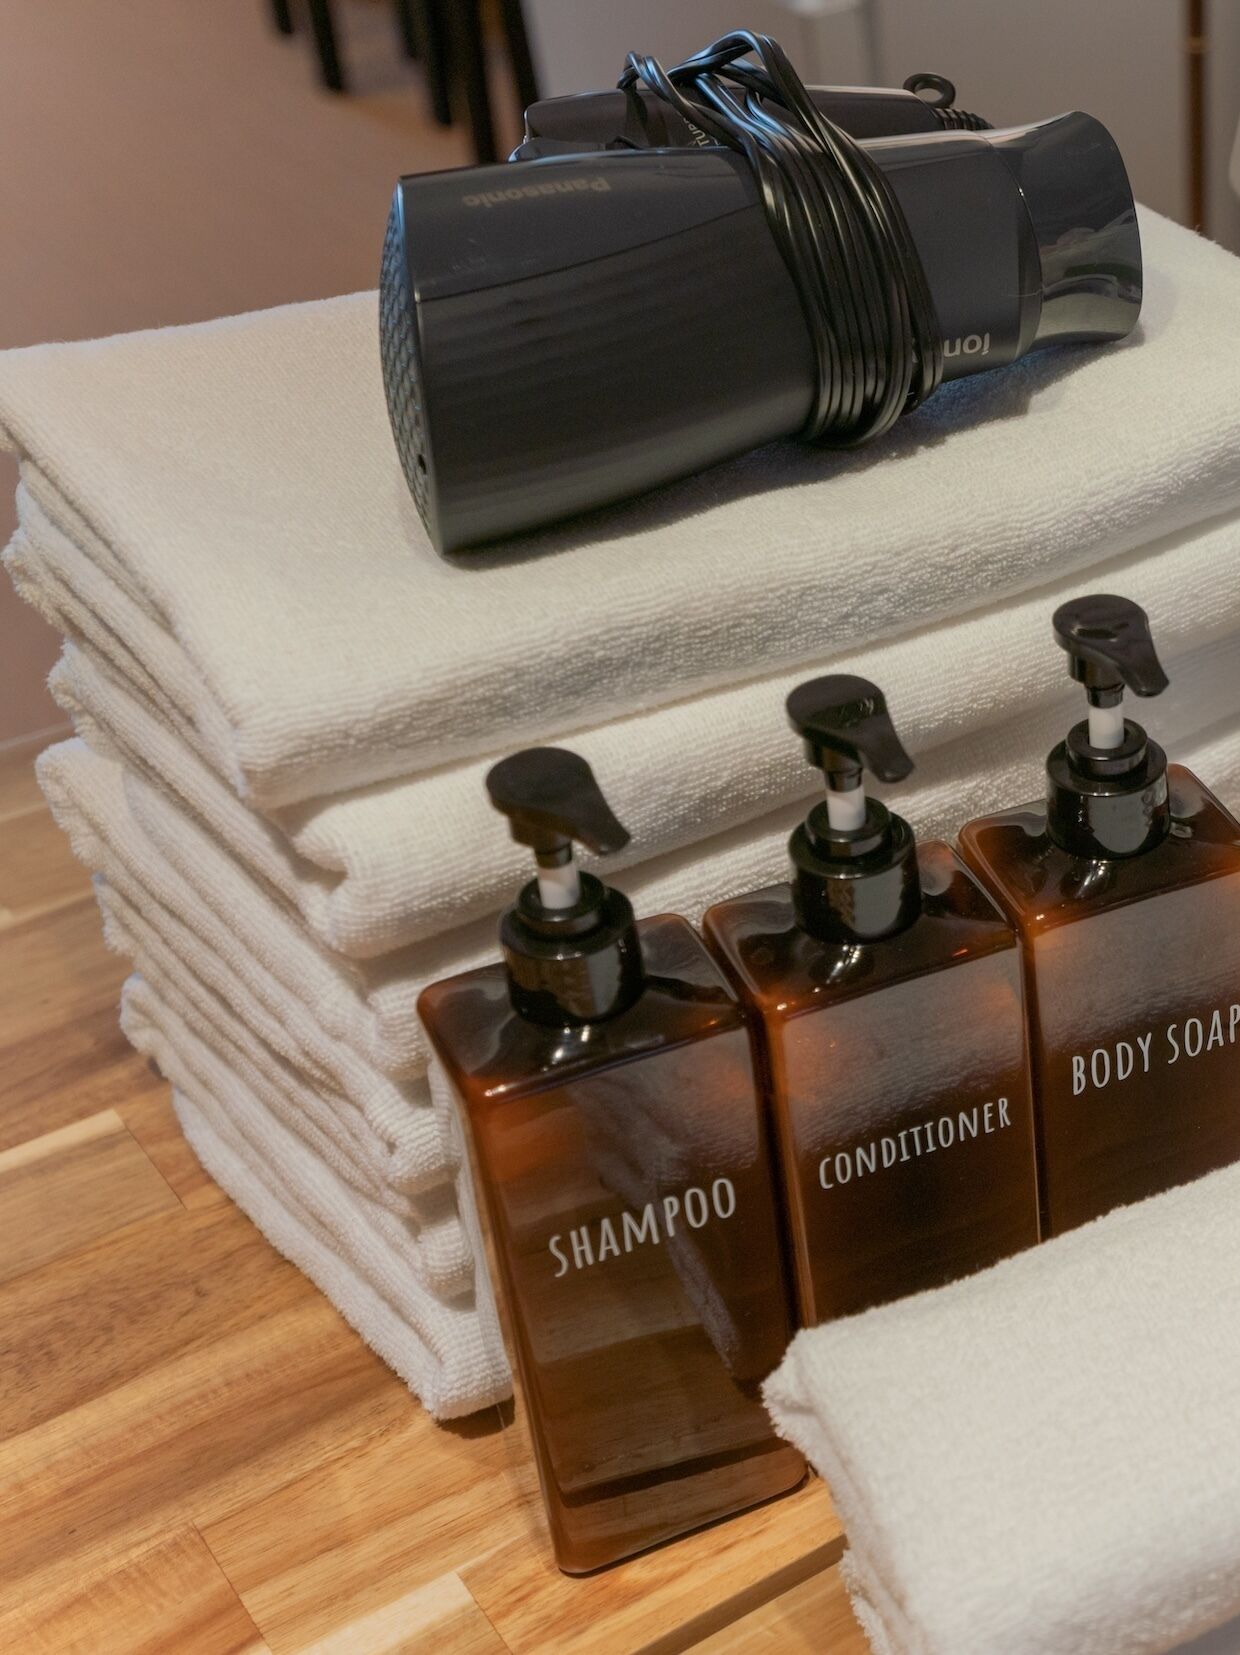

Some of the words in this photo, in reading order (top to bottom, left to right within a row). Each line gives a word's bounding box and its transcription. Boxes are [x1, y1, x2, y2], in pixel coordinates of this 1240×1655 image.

[462, 176, 611, 208] Panasonic
[1072, 1032, 1152, 1096] BODY
[818, 1097, 1012, 1190] CONDITIONER
[548, 1178, 737, 1278] SHAMPOO
